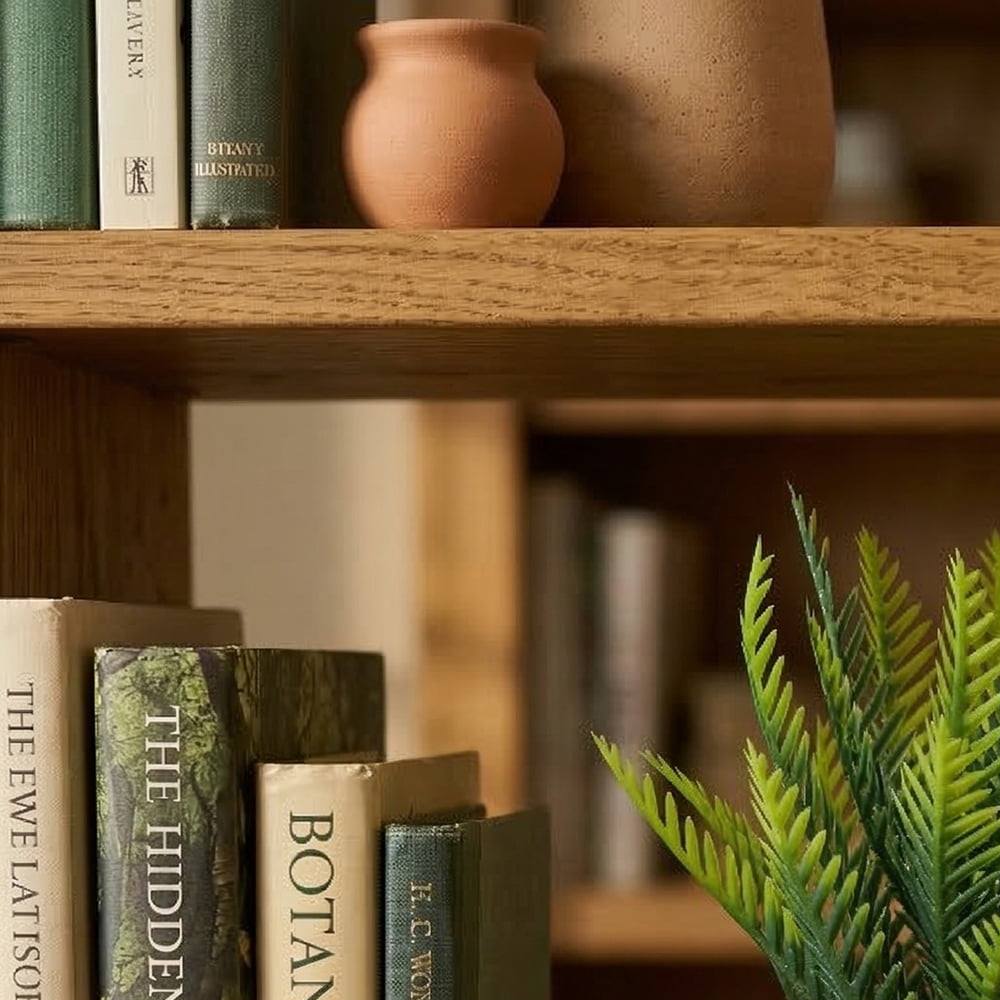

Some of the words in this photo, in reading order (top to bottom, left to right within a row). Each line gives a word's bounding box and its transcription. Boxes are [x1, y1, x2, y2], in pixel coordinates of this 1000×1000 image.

[7, 682, 35, 756] THE
[145, 704, 182, 804] THE
[9, 768, 38, 848] EWE
